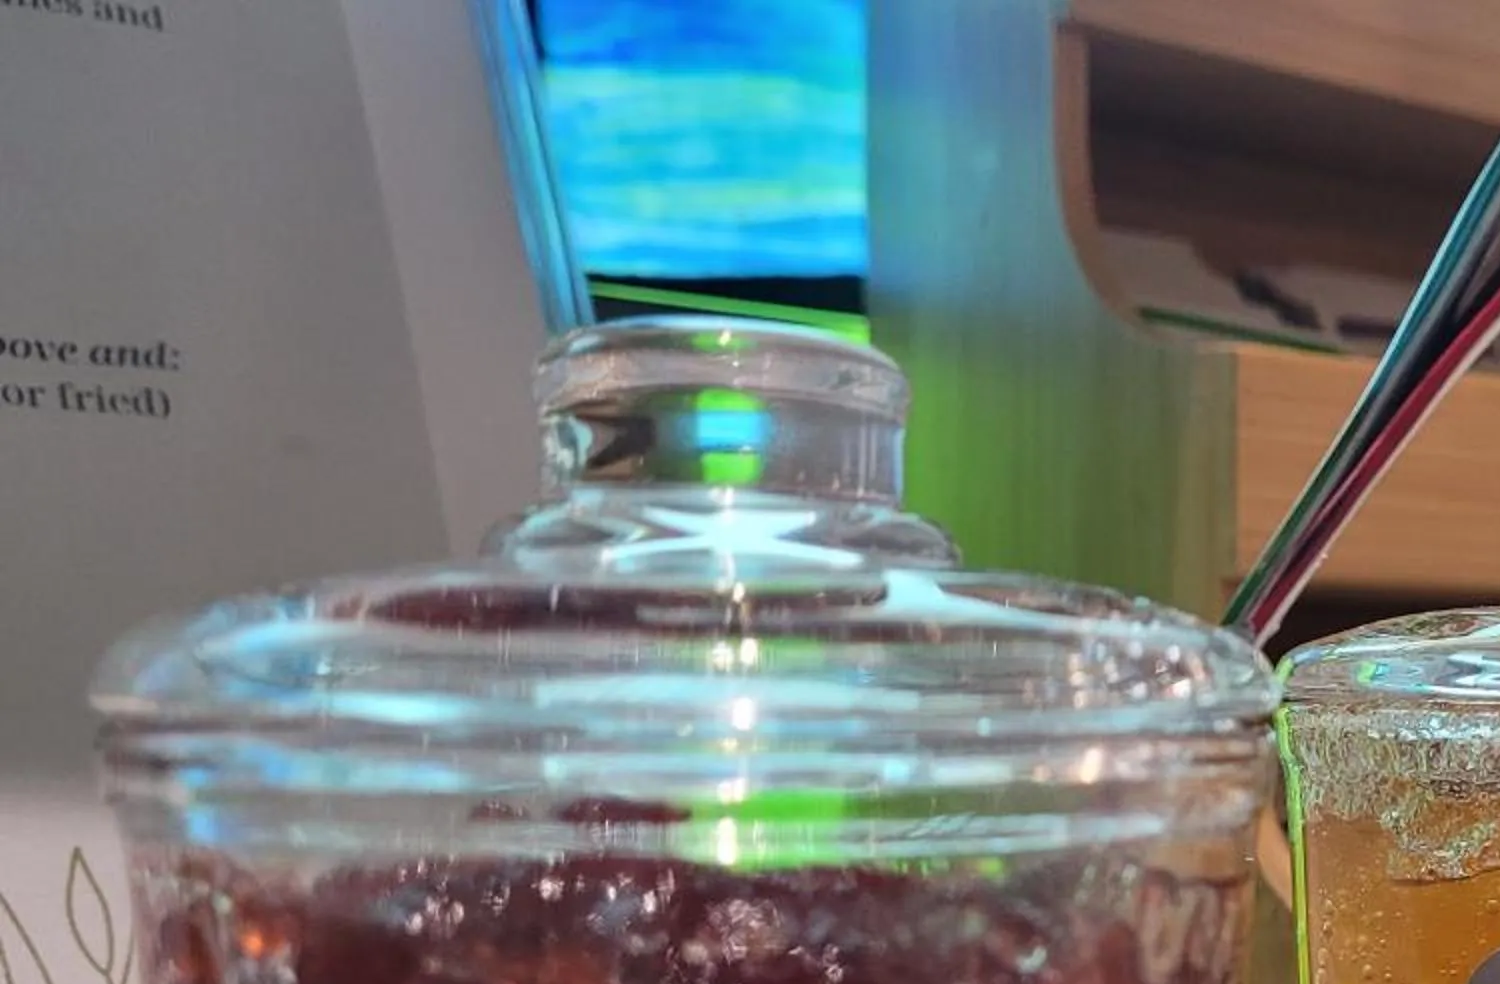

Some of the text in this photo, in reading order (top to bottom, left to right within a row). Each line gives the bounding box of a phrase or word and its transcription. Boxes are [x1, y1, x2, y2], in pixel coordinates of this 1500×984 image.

[93, 0, 164, 32] and
[88, 340, 181, 371] and:
[1, 380, 171, 420] or fried)
